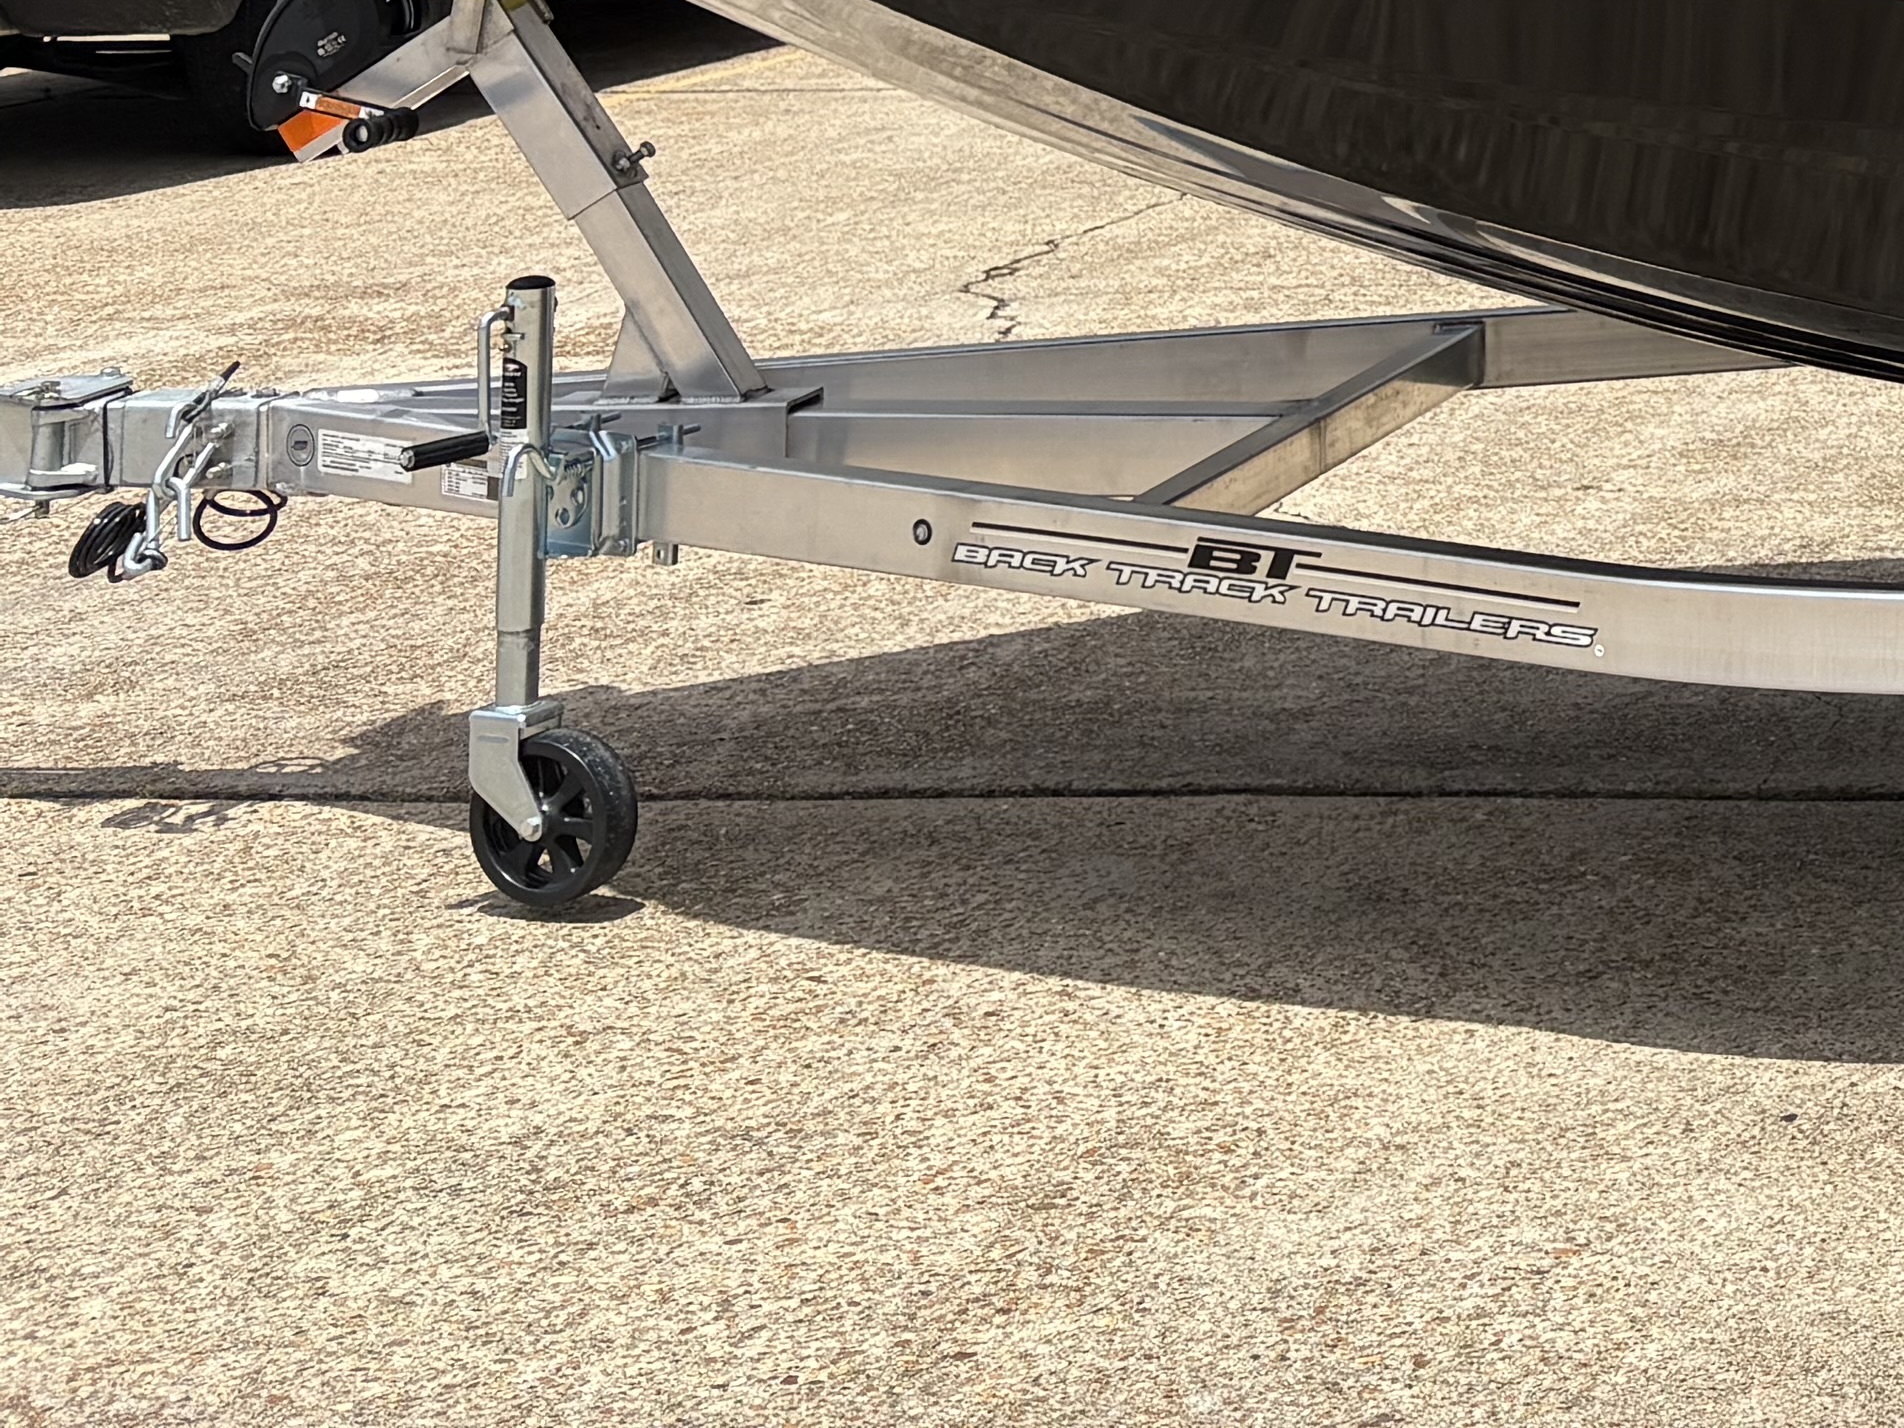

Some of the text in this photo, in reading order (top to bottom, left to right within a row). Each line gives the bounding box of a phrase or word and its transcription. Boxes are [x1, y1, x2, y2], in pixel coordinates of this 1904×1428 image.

[952, 542, 1598, 648] BACK TRACK TRAILERS
[1188, 537, 1322, 580] BT
